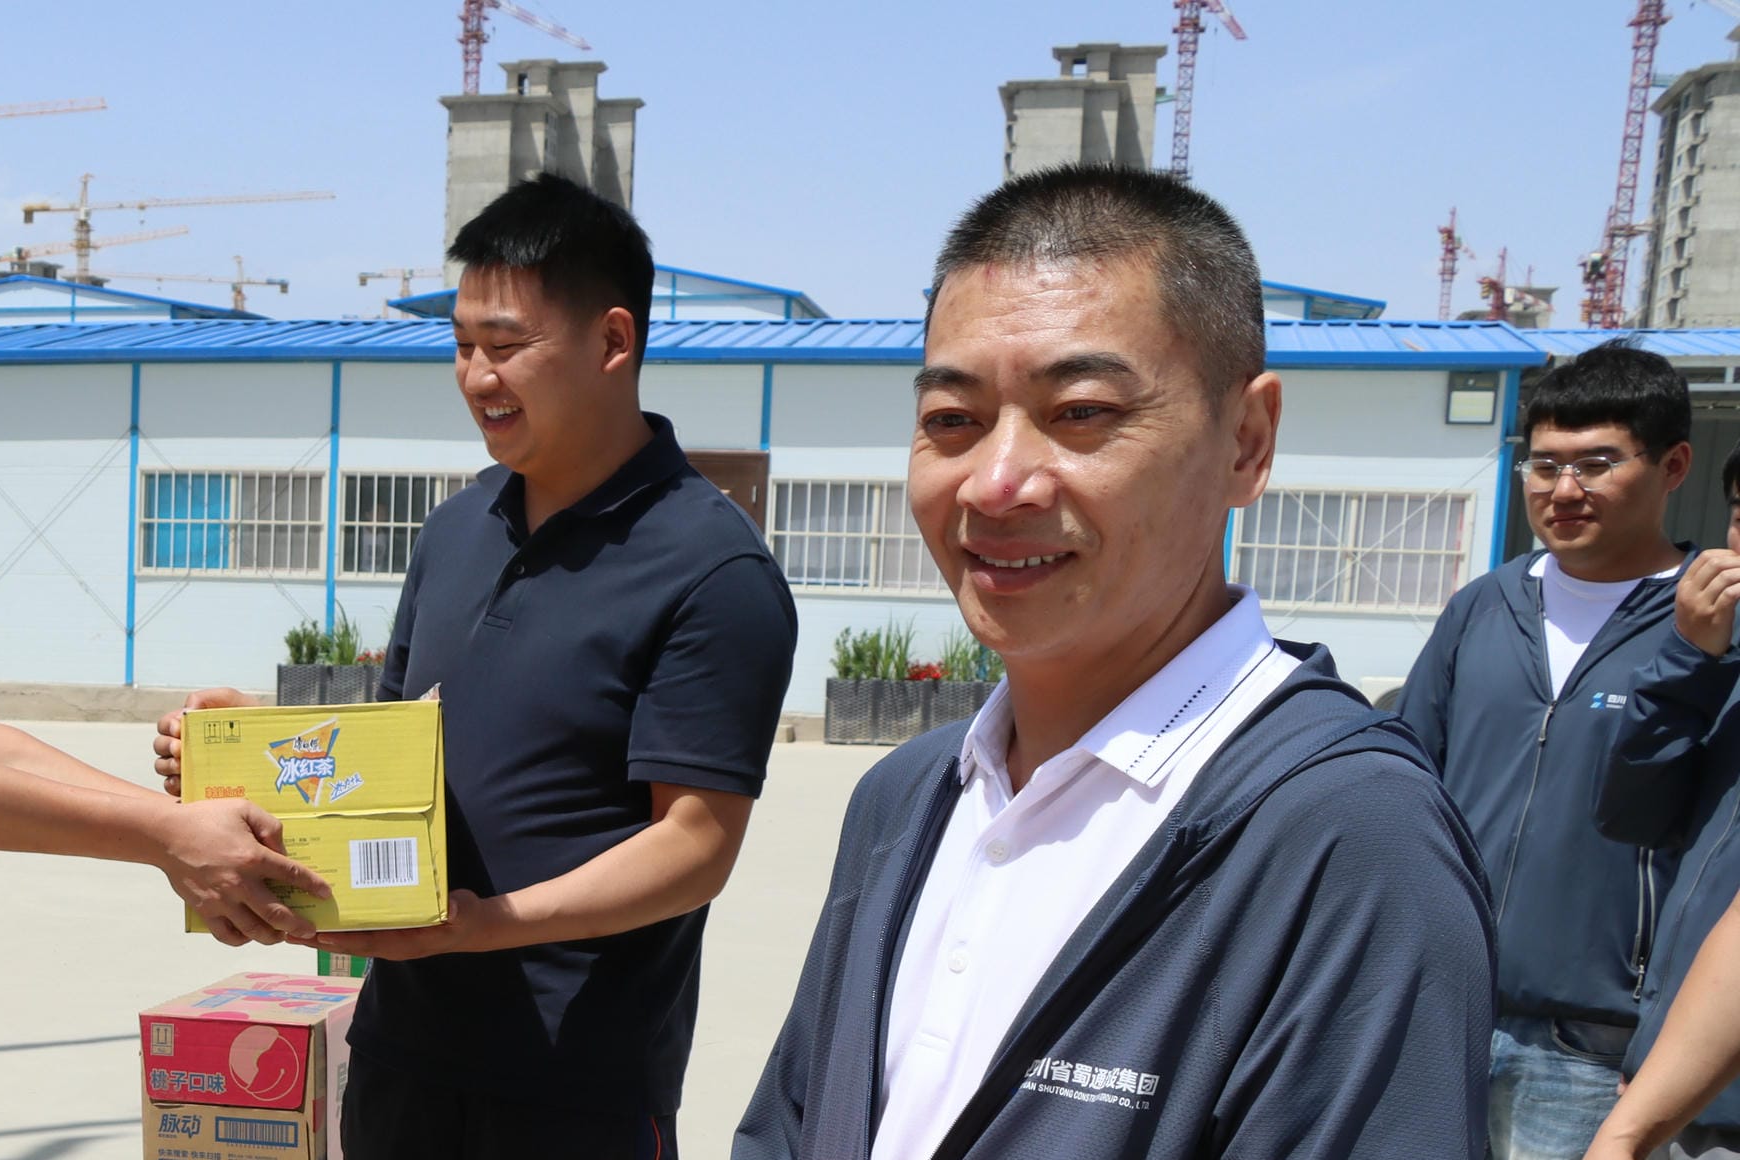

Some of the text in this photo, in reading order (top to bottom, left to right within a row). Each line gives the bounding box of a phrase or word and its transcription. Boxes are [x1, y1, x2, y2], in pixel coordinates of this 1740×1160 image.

[276, 756, 335, 791] 冰红茶
[150, 1068, 227, 1095] 桃子口味
[1038, 1084, 1073, 1099] SHUTONG
[159, 1113, 202, 1138] 脉动
